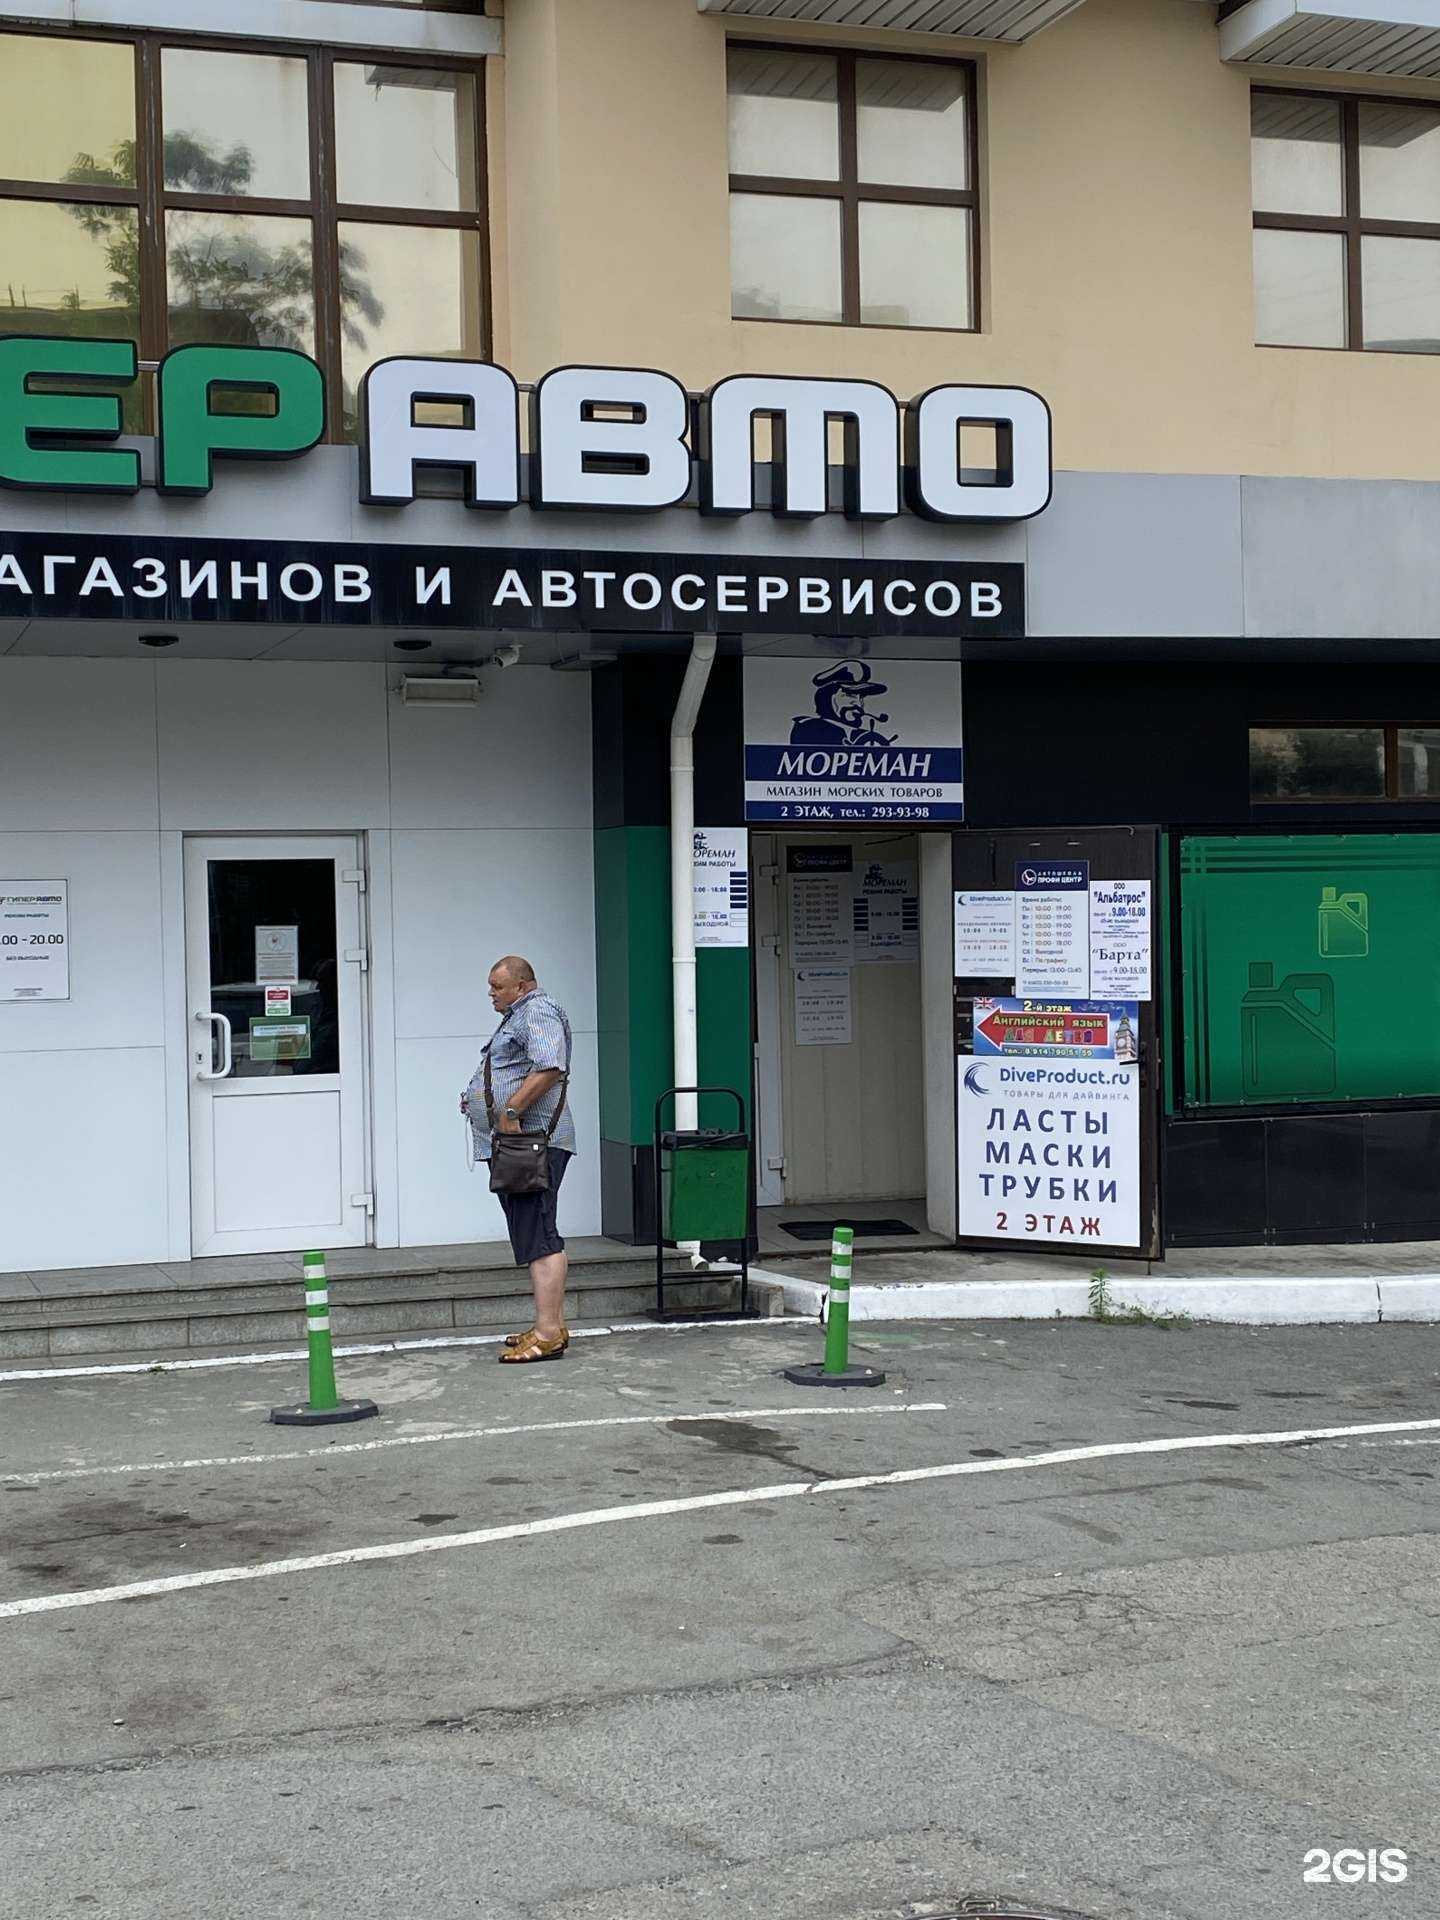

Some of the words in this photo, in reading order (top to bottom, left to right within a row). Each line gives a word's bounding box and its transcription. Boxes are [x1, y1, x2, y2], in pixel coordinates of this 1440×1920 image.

[0, 554, 372, 602] АГАЗИНОВ
[416, 566, 452, 603] И
[493, 568, 1003, 618] АВТОСЕРВИСОВ
[777, 751, 931, 777] МОРЕМАН
[766, 786, 822, 797] МАГАЗИН
[828, 787, 885, 798] МОРСКИХ
[890, 788, 943, 798] ТОВАРОВ
[781, 806, 788, 817] 2
[794, 805, 834, 818] ЭТАЖ,
[872, 807, 930, 818] 293-93-98
[693, 849, 736, 859] ОРЕМАН
[1093, 891, 1146, 906] "Альбатрос"
[29, 934, 64, 945] 20.00
[1024, 1000, 1043, 1012] 2-й
[1046, 1005, 1073, 1013] этаж
[992, 1015, 1065, 1027] Английский
[1072, 1019, 1105, 1028] язык
[999, 1066, 1130, 1085] DiveProduct.ru
[1003, 1089, 1045, 1099] ТОВАРЫ
[1048, 1090, 1069, 1100] ДЛЯ
[1073, 1090, 1130, 1101] ДАЙВИНГА
[987, 1108, 1108, 1135] ЛАСТЫ
[985, 1140, 1111, 1169] МАСКИ
[979, 1173, 1117, 1204] ТРУБКИ
[996, 1212, 1008, 1231] 2
[1024, 1213, 1101, 1236] ЭТАЖ
